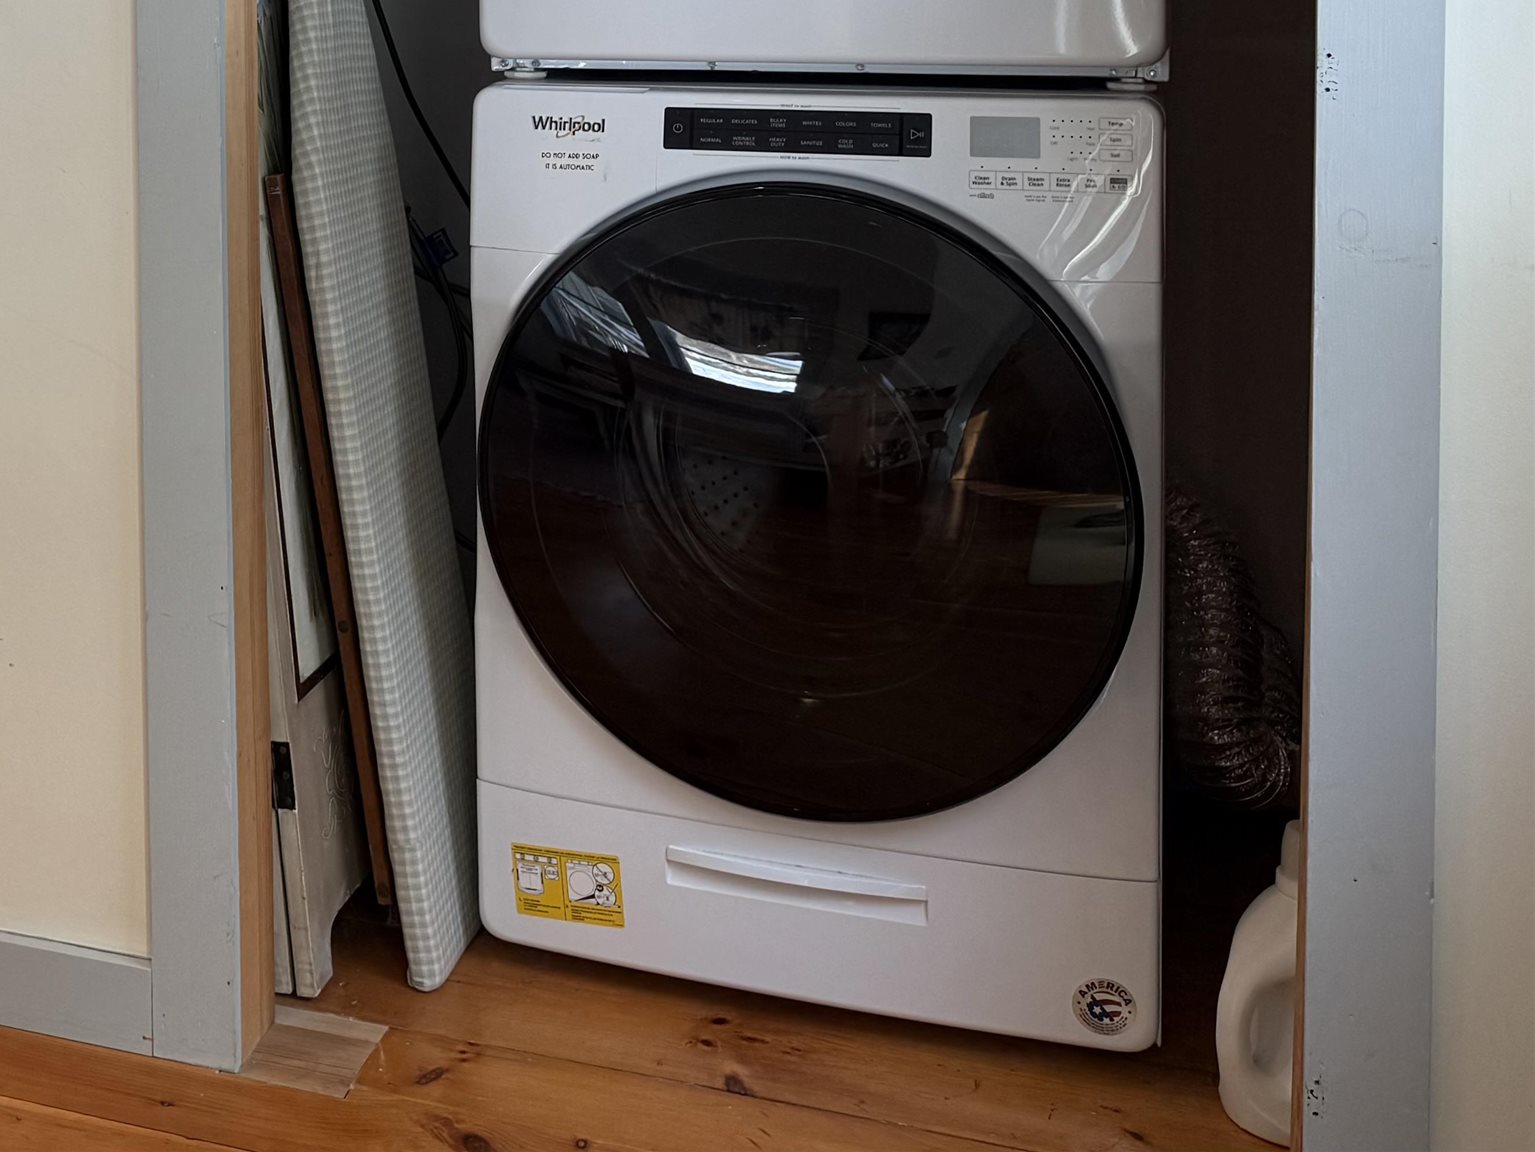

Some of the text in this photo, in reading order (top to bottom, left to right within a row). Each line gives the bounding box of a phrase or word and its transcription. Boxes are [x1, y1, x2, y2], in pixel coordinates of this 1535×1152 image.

[532, 115, 606, 137] Whirlpool
[541, 151, 552, 159] DO
[567, 152, 581, 160] ADD
[558, 163, 595, 171] AUTOMATIC
[1078, 980, 1133, 1007] AMERICA
